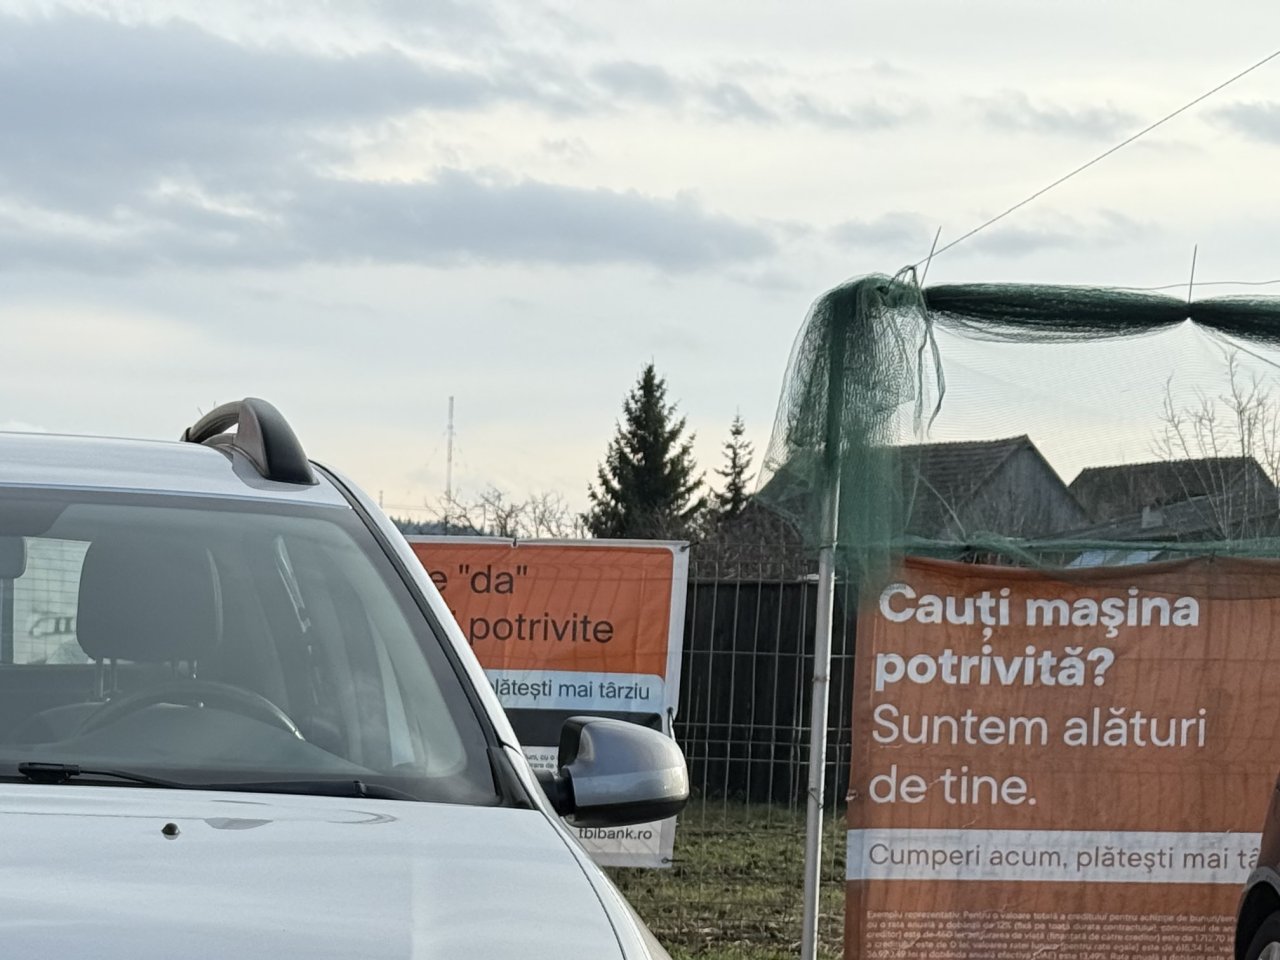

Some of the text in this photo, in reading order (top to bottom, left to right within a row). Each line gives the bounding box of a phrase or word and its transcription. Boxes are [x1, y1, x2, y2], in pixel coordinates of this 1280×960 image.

[458, 564, 528, 595] "da"
[469, 612, 614, 647] potrivite
[878, 582, 1012, 642] Cauți
[874, 644, 1116, 693] potrivită?
[558, 681, 593, 698] mai
[598, 682, 650, 700] târziu
[872, 702, 1208, 749] Suntem alături
[868, 764, 1038, 806] de tine.
[869, 843, 981, 871] Cumperi
[989, 849, 1068, 870] acum,
[1183, 846, 1229, 869] mai
[1237, 846, 1261, 870] tâ
